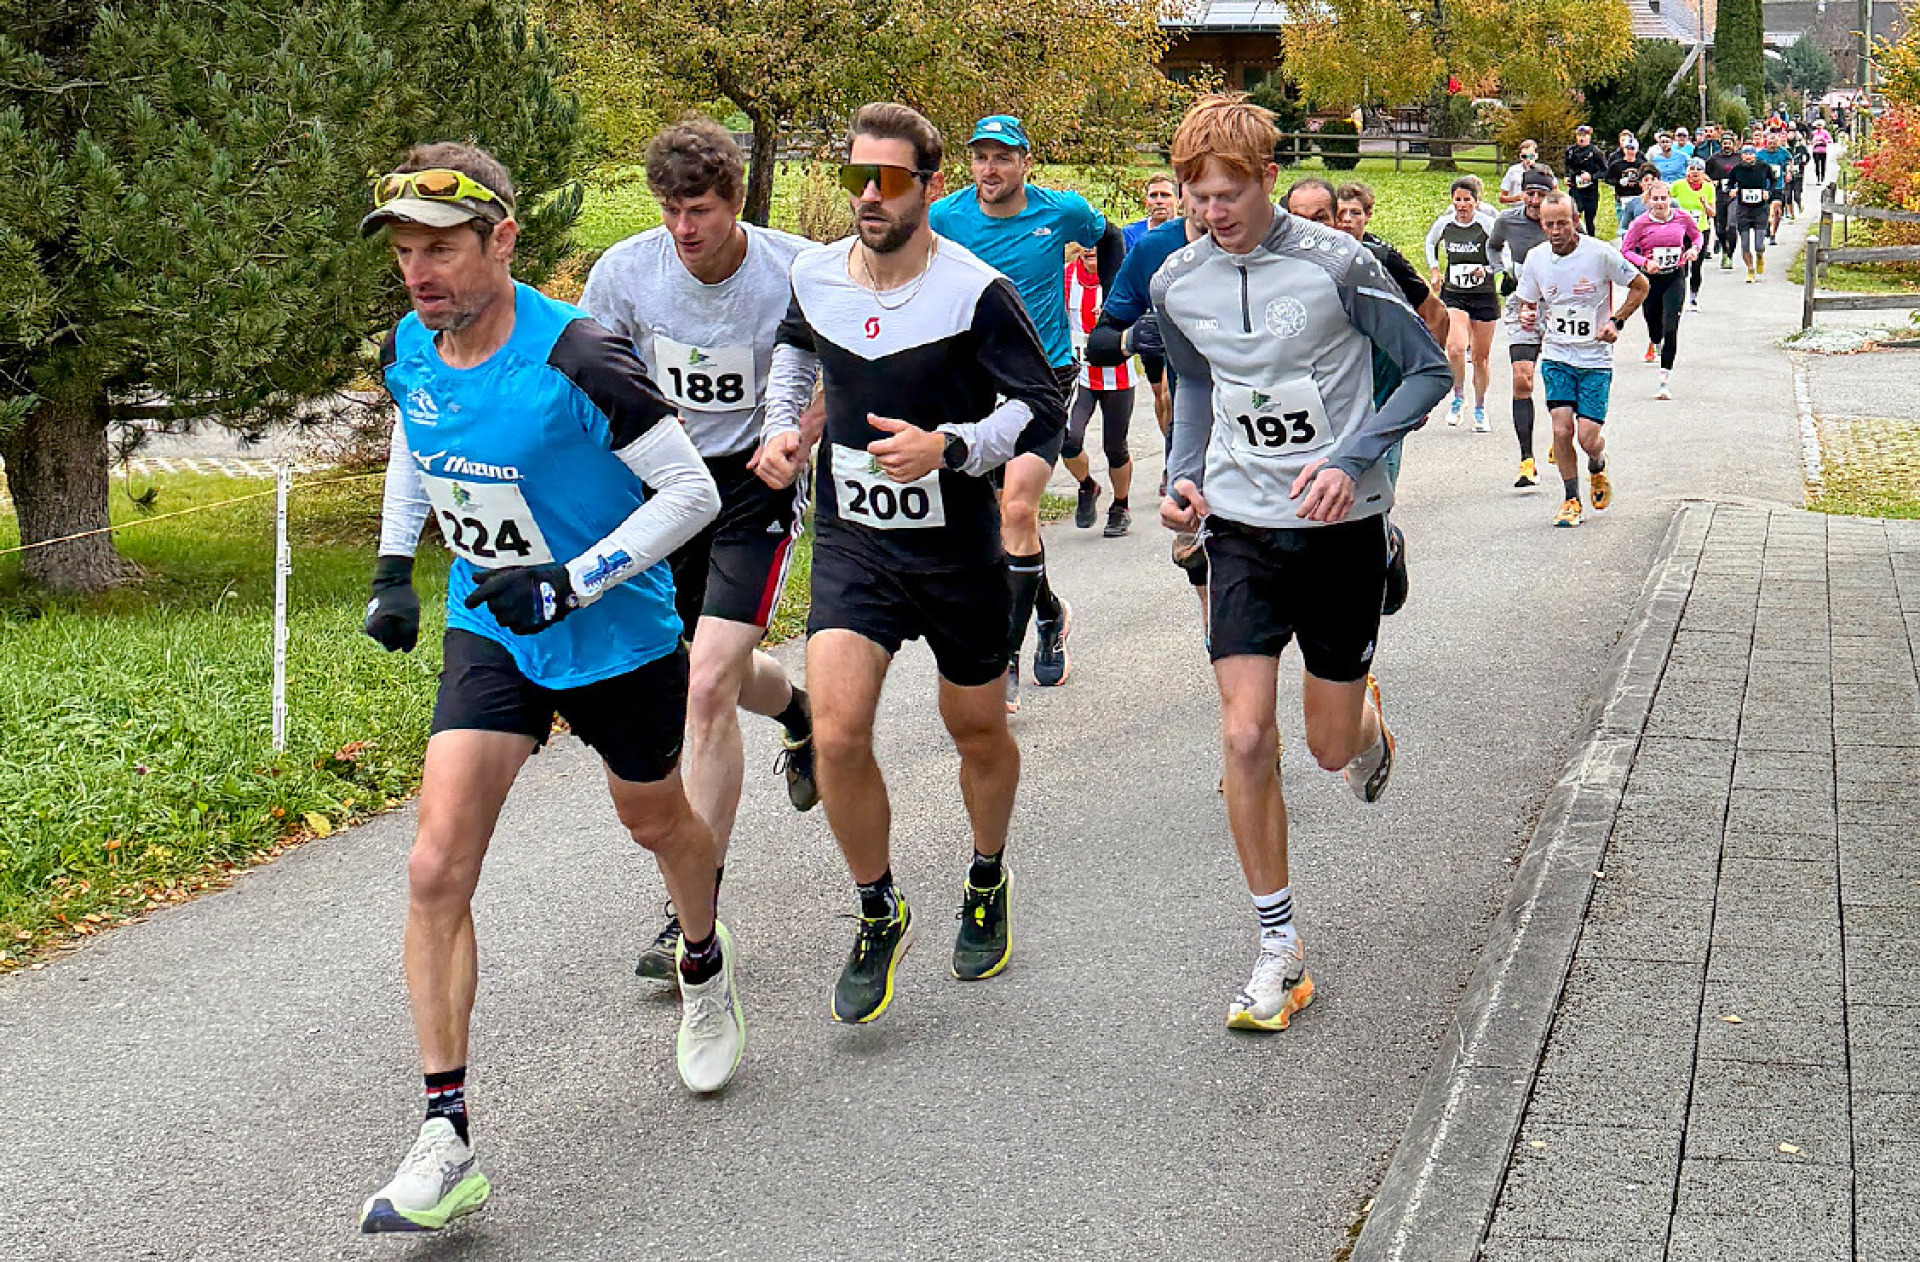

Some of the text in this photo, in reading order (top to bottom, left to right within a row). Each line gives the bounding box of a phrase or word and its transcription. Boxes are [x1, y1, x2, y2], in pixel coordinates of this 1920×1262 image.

[1556, 318, 1590, 336] 218
[667, 367, 744, 404] 188
[1236, 409, 1316, 447] 193
[845, 480, 929, 520] 200
[442, 510, 532, 558] 224
